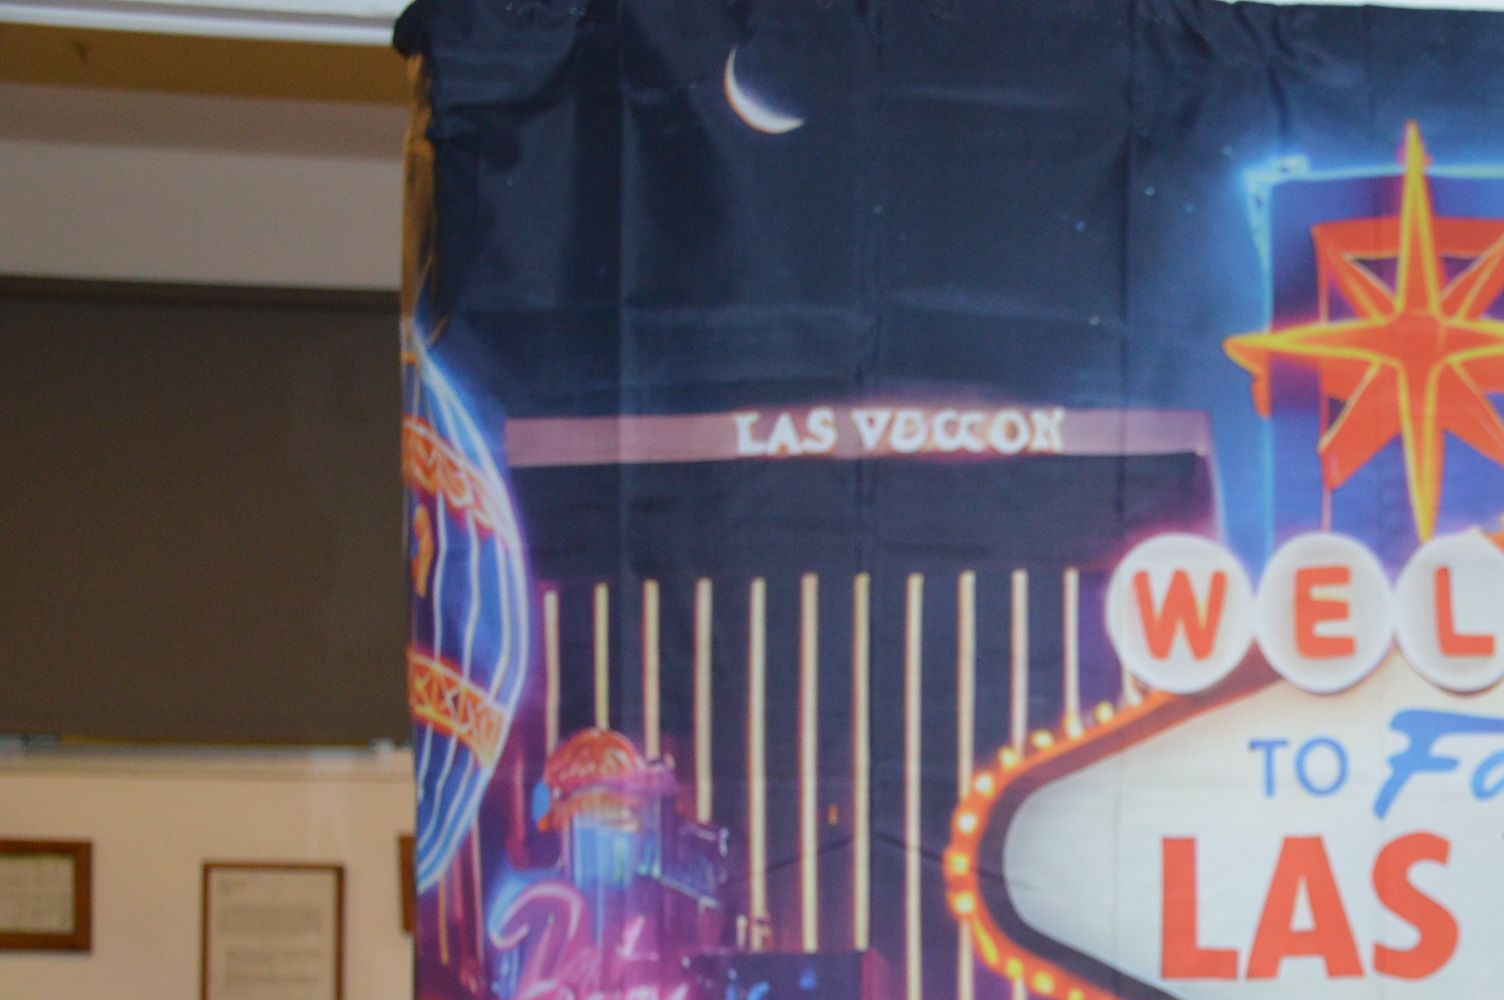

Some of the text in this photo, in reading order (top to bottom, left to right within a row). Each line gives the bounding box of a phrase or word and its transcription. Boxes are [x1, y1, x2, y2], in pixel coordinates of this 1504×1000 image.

[734, 408, 836, 455] LAS
[1248, 738, 1348, 798] TO
[1161, 831, 1459, 981] LAS
